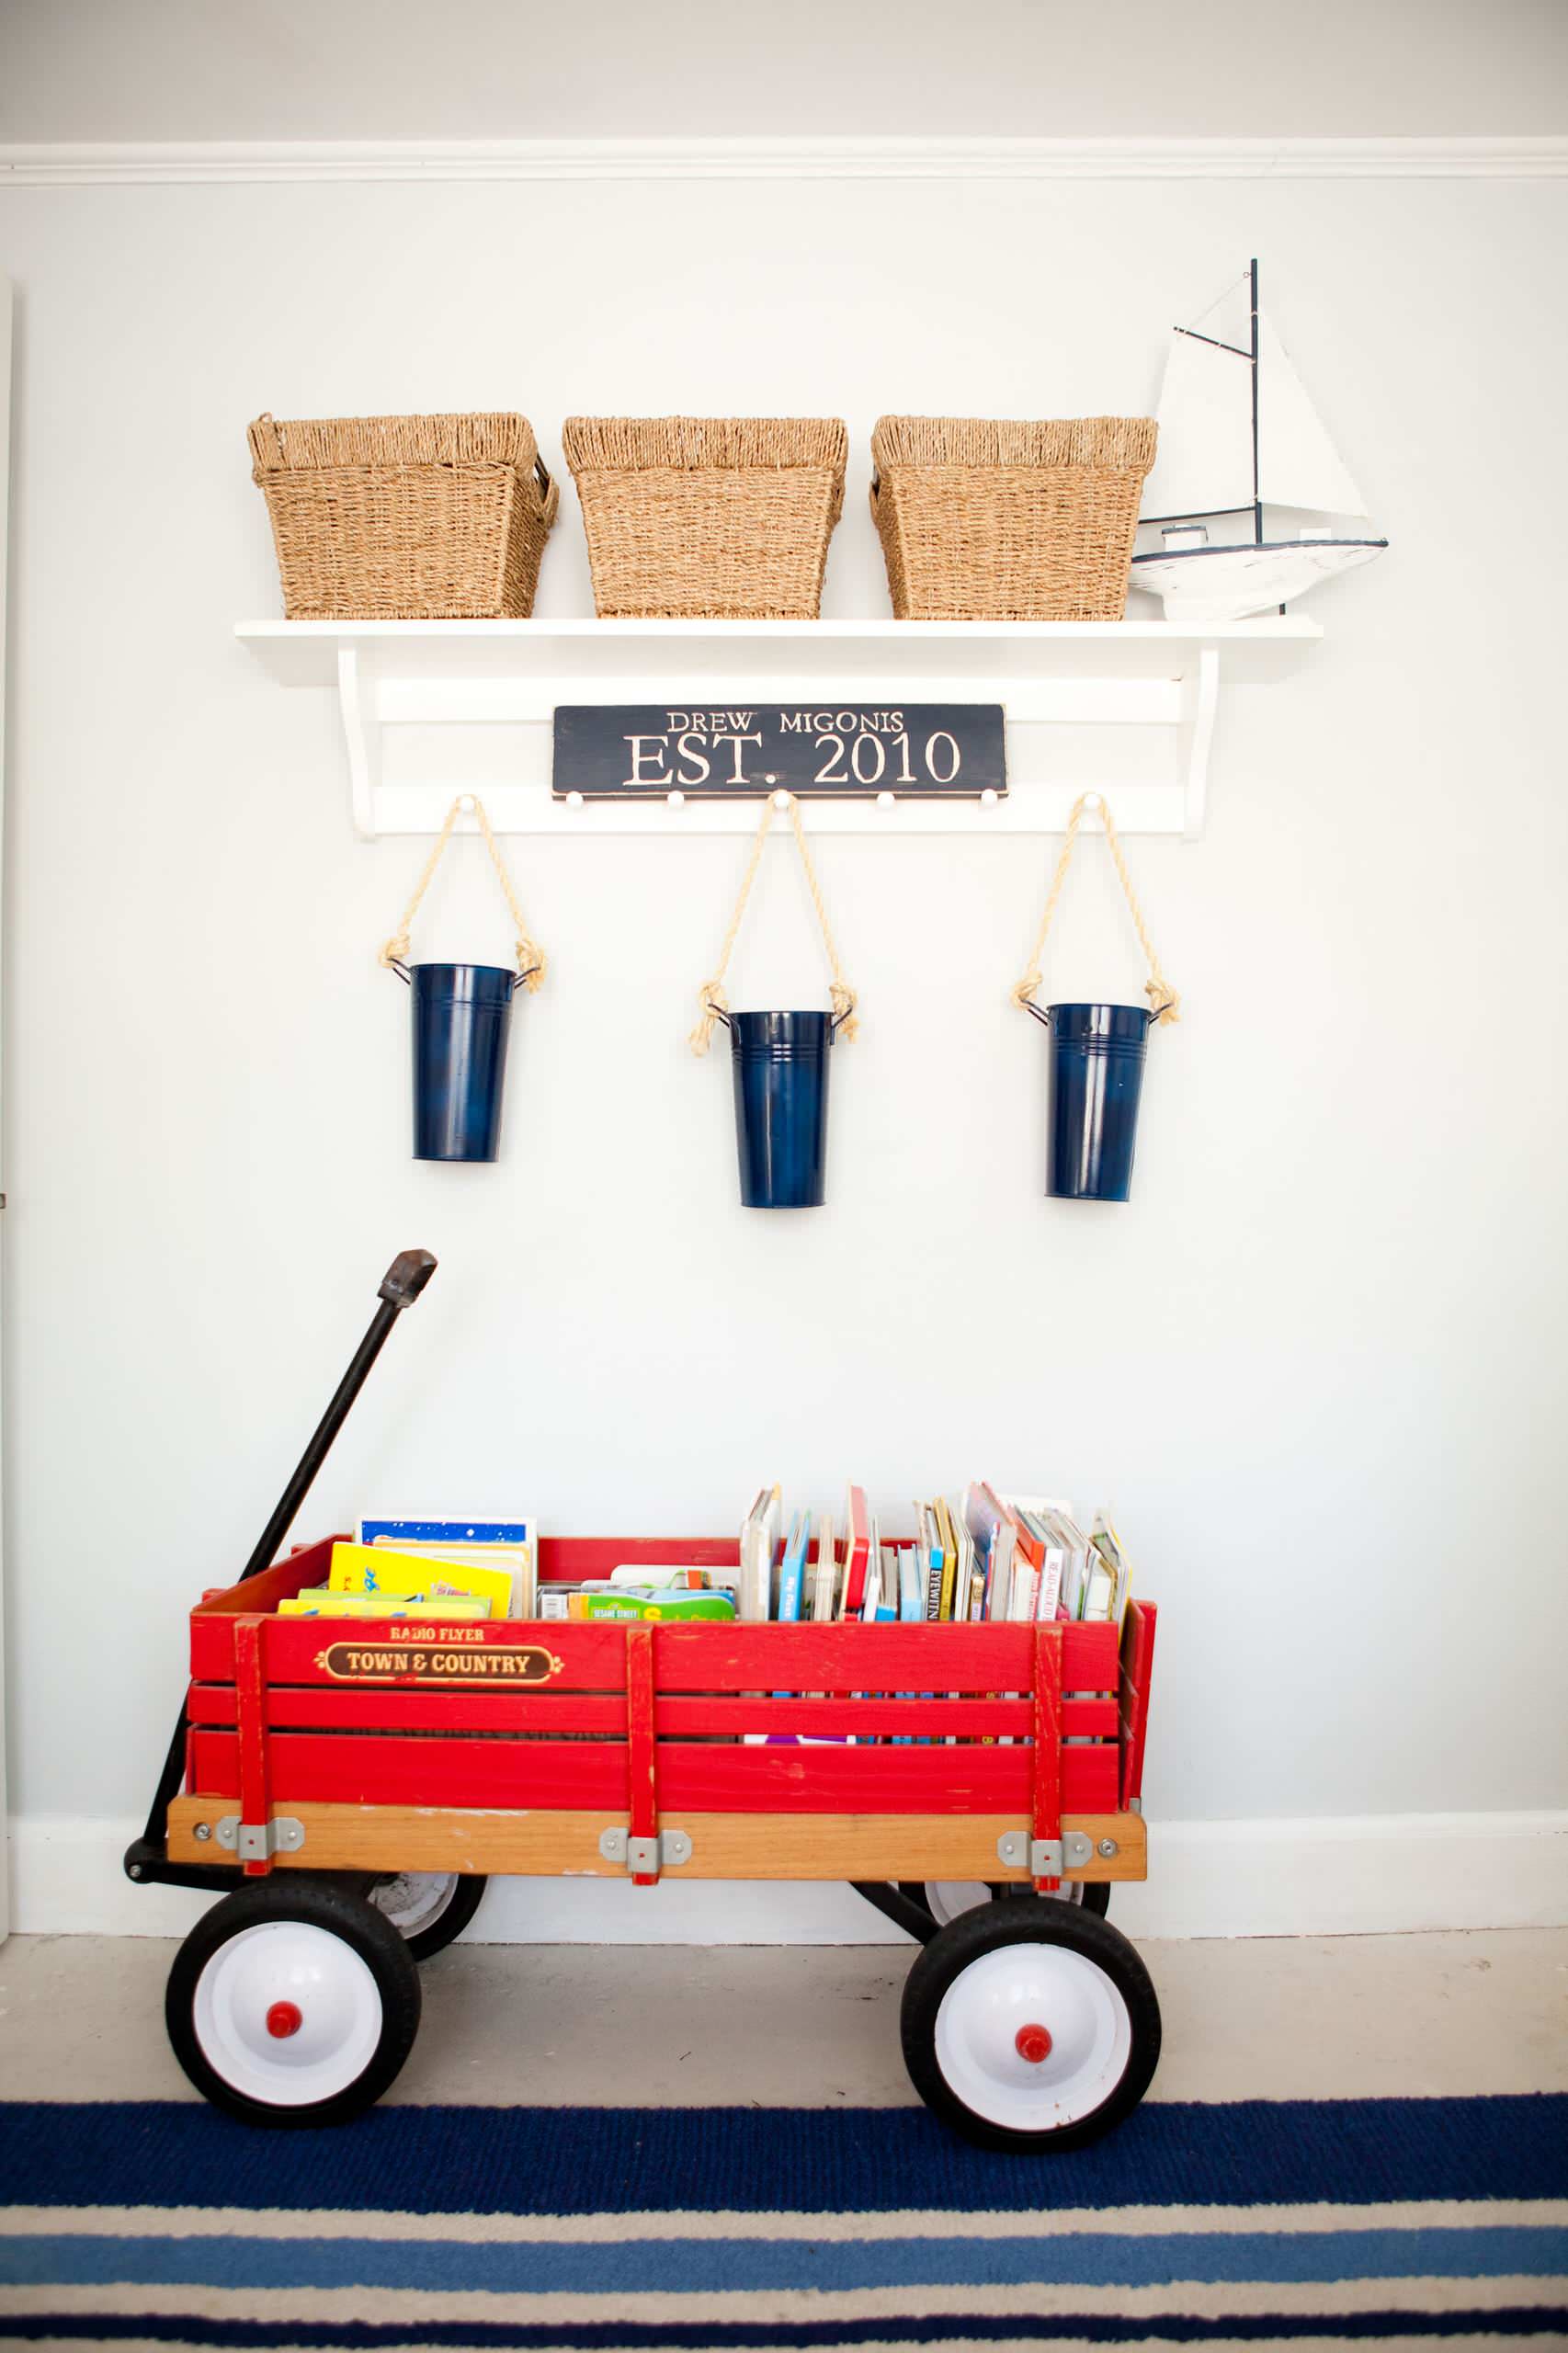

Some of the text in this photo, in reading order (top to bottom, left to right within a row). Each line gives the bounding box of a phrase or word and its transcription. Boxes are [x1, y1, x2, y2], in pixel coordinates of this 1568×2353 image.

[666, 711, 904, 733] DREW MIGONIS
[622, 732, 960, 786] EST. 2010
[390, 1627, 484, 1642] RADIO FLYER
[347, 1652, 530, 1674] TOWN & COUNTRY
